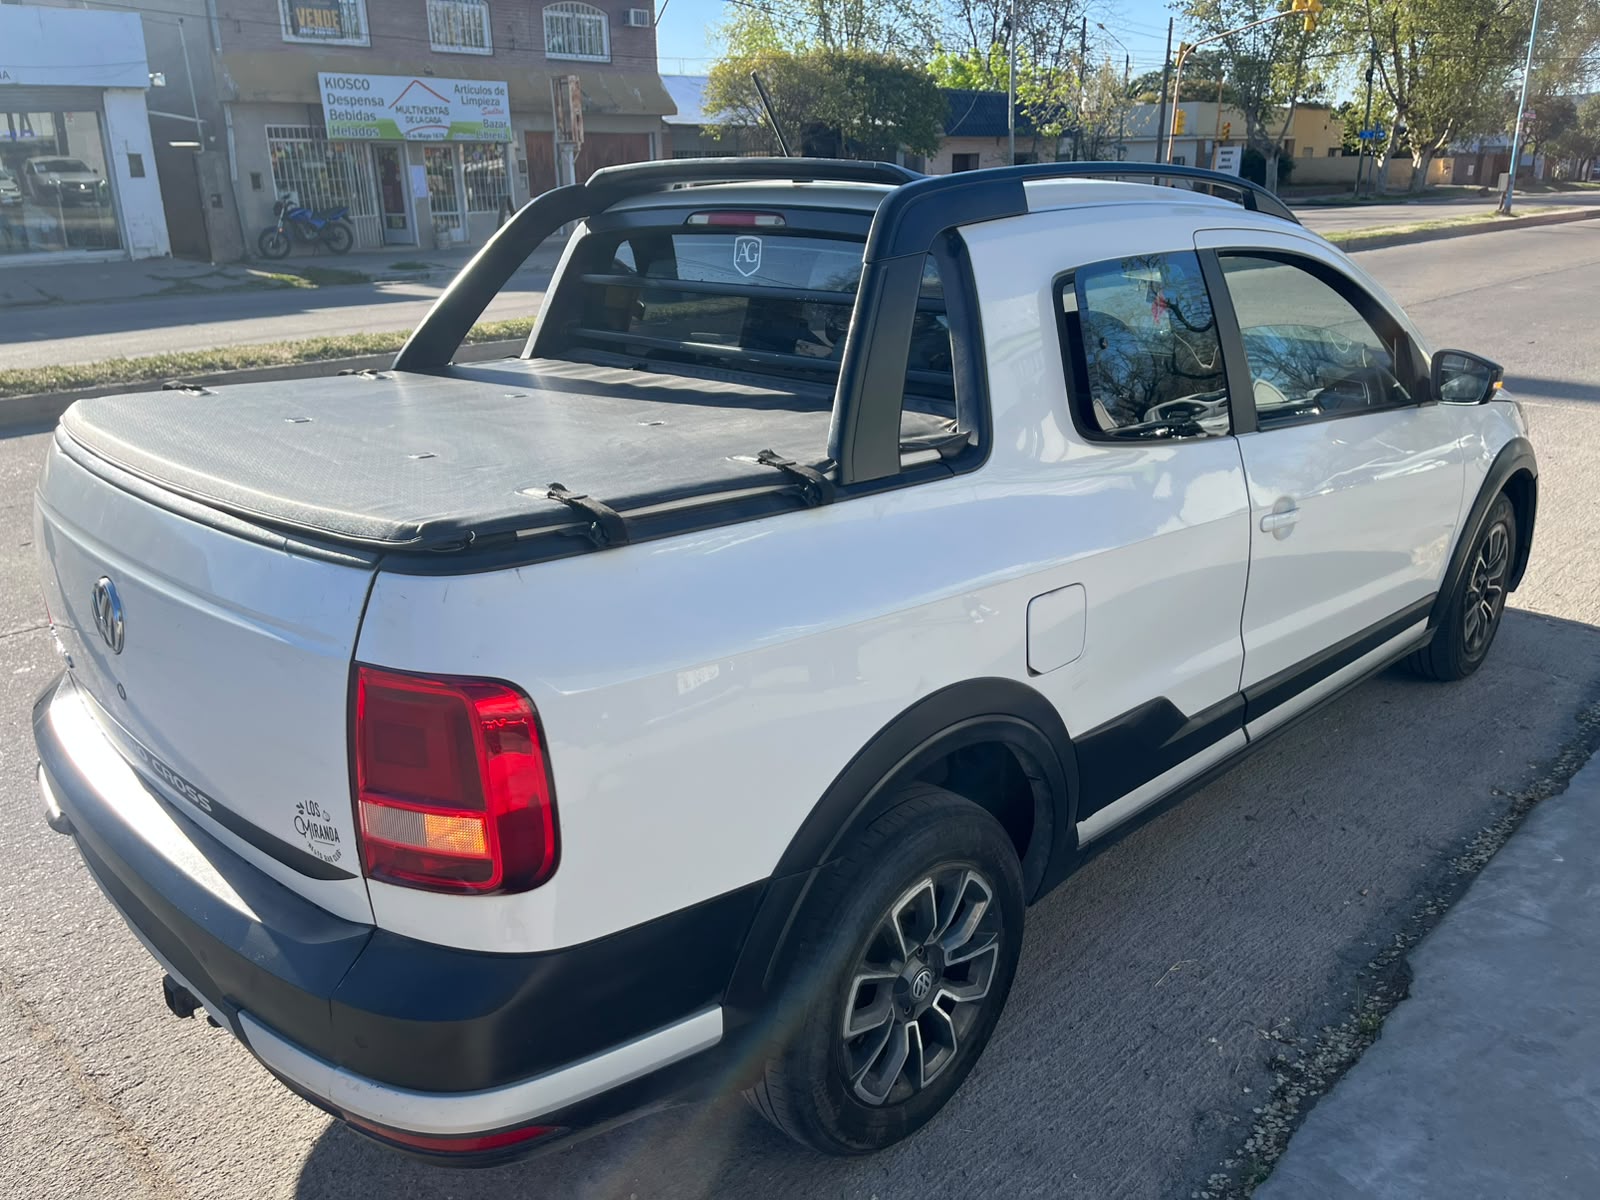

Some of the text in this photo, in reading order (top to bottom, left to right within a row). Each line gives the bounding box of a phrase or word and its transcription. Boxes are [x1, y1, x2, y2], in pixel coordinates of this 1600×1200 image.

[296, 8, 339, 27] VENDE
[324, 77, 370, 91] KIOSCO
[494, 86, 505, 96] de
[327, 93, 385, 107] Despensa
[461, 96, 501, 107] Limpieza
[329, 109, 377, 121] Bebidas
[395, 105, 450, 116] MULTIVENTAS
[405, 116, 443, 125] DE LA CASA
[483, 119, 507, 129] Bazar
[332, 125, 379, 137] Helados
[417, 131, 432, 140] Mayo
[737, 242, 758, 263] AG
[152, 759, 212, 812] CROSS
[305, 799, 321, 818] LOS
[294, 815, 340, 843] MIRANDA
